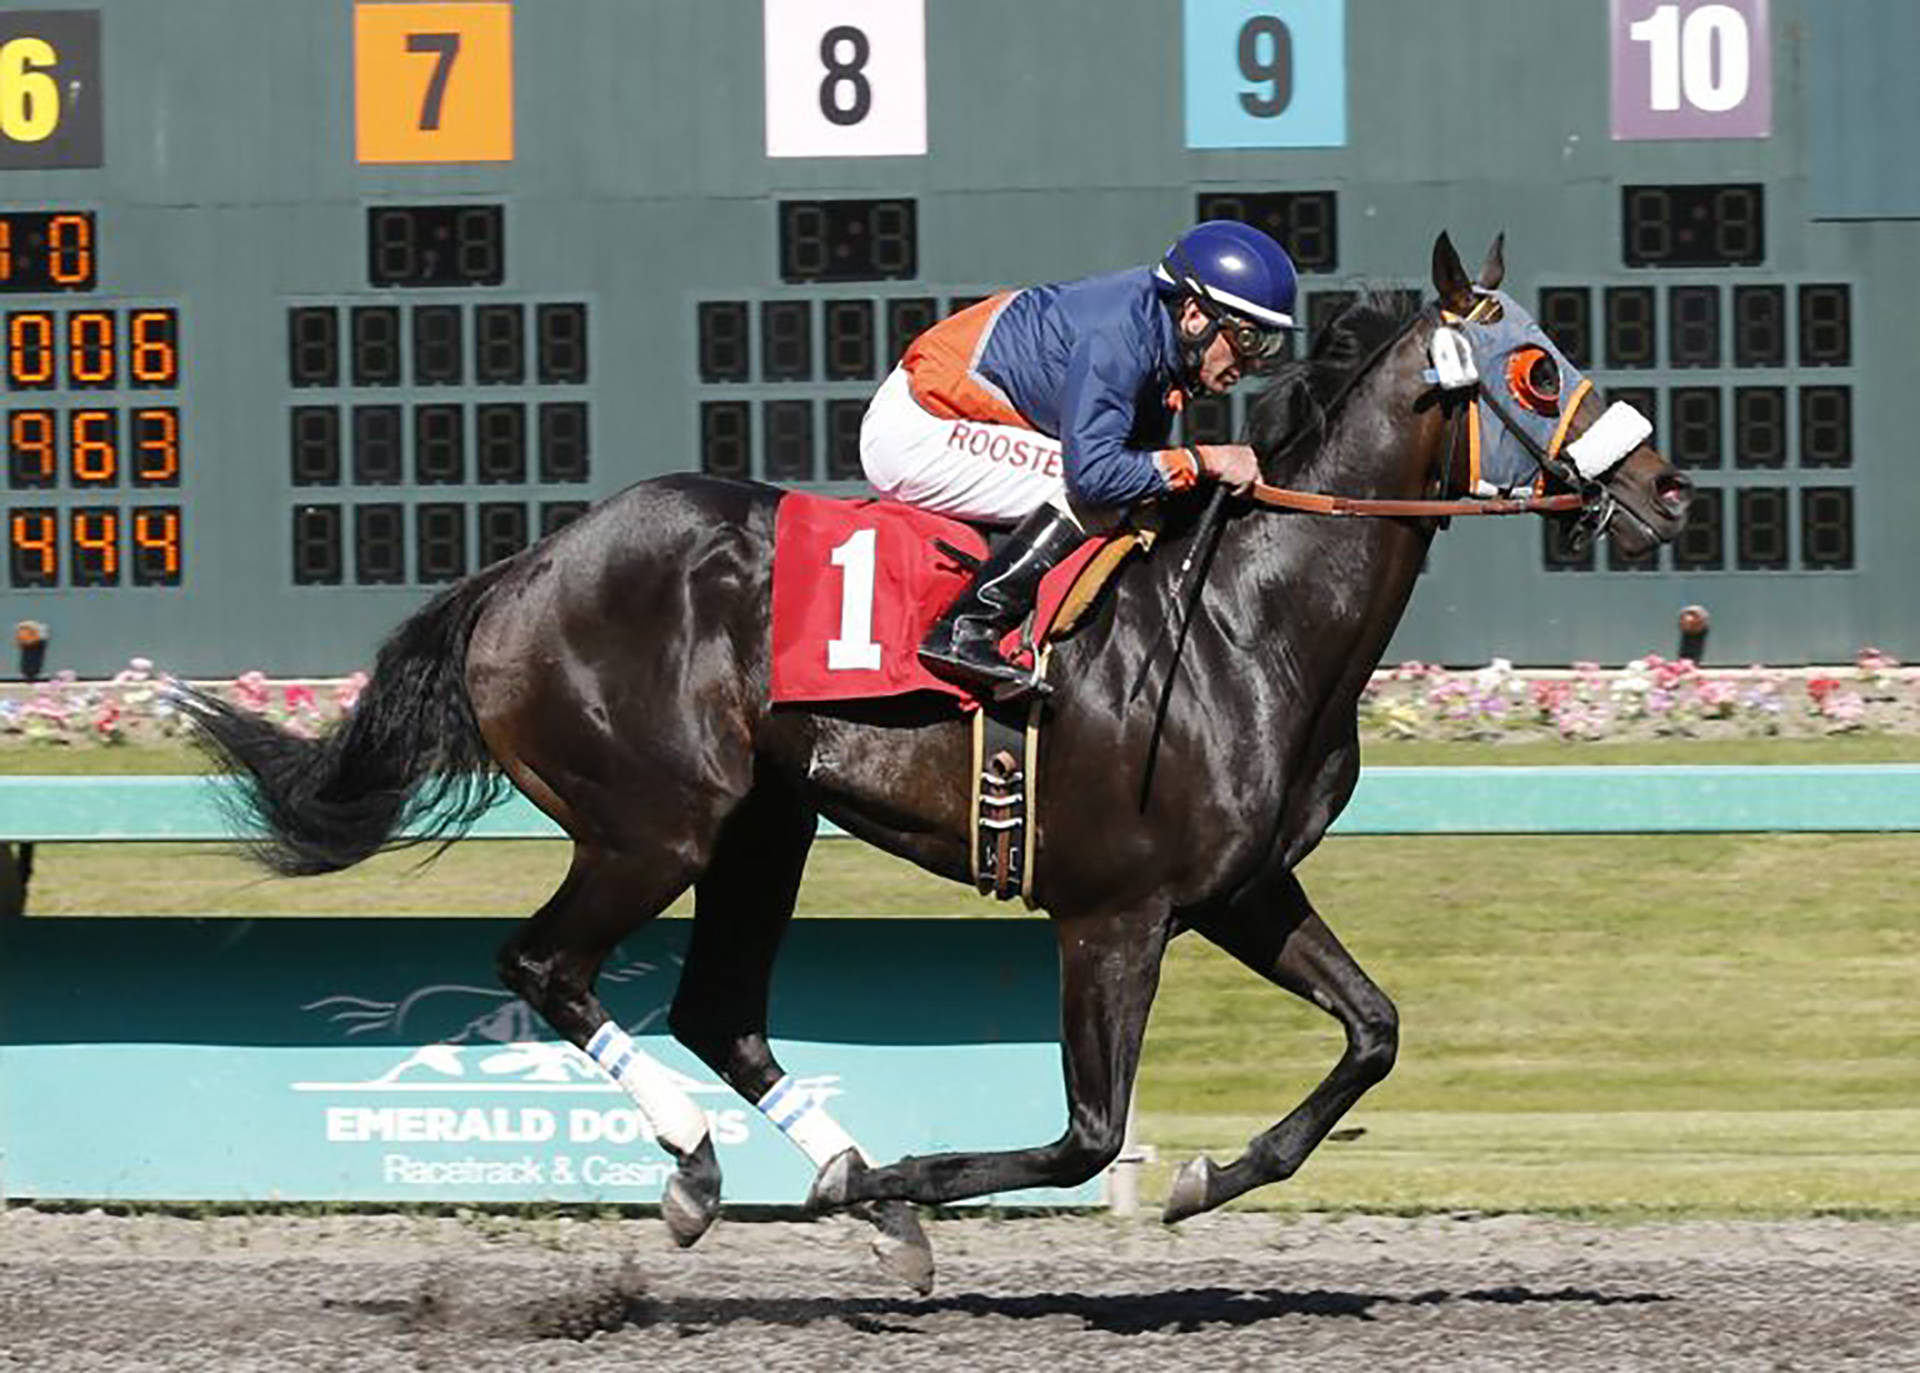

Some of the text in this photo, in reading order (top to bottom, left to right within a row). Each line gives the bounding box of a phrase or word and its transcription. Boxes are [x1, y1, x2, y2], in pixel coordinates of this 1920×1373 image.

[0, 37, 60, 142] 6
[405, 33, 460, 131] 7
[818, 25, 872, 126] 8
[1237, 15, 1293, 118] 9
[1630, 4, 1750, 112] 10
[948, 423, 1062, 478] ROOSTE
[827, 528, 882, 671] 1
[326, 1107, 750, 1144] EMERALD DOS
[383, 1154, 677, 1186] Racetrack & Casin
